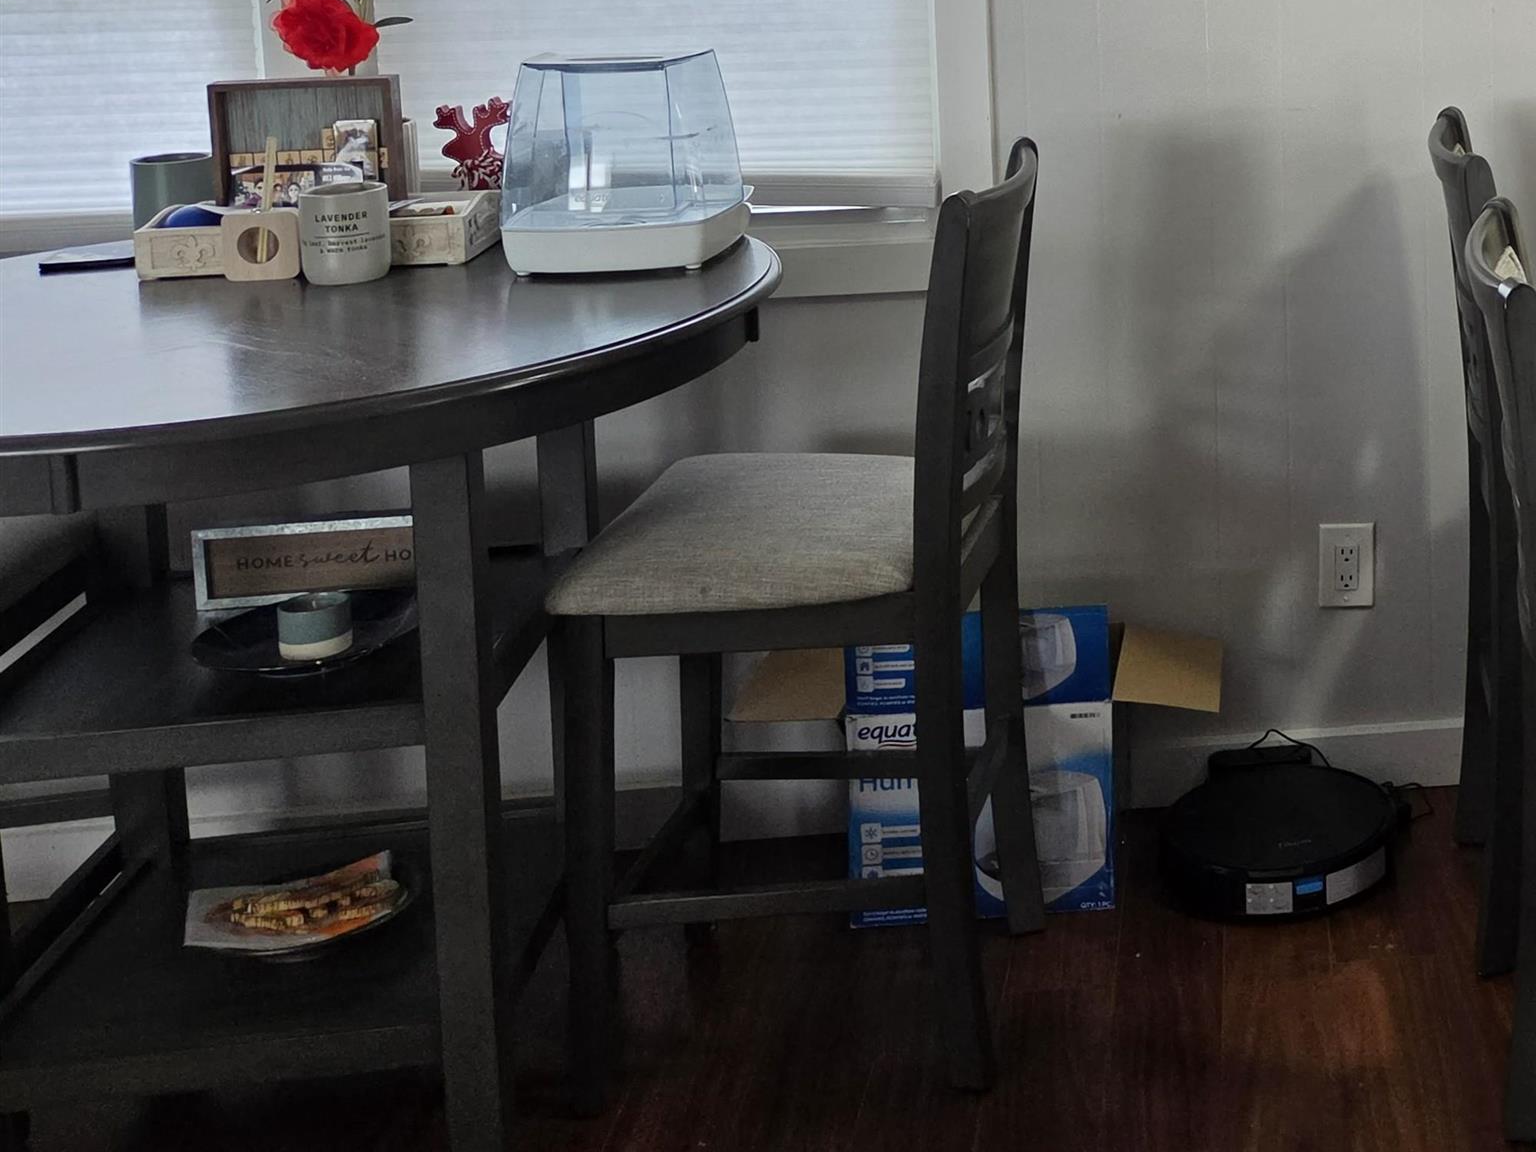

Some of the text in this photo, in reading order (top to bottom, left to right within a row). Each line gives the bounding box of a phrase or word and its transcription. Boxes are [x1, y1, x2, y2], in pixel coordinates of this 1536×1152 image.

[315, 211, 368, 222] LAVENDER
[325, 223, 359, 233] TONKA
[237, 538, 412, 570] HOME sweet HO
[857, 724, 915, 744] equa
